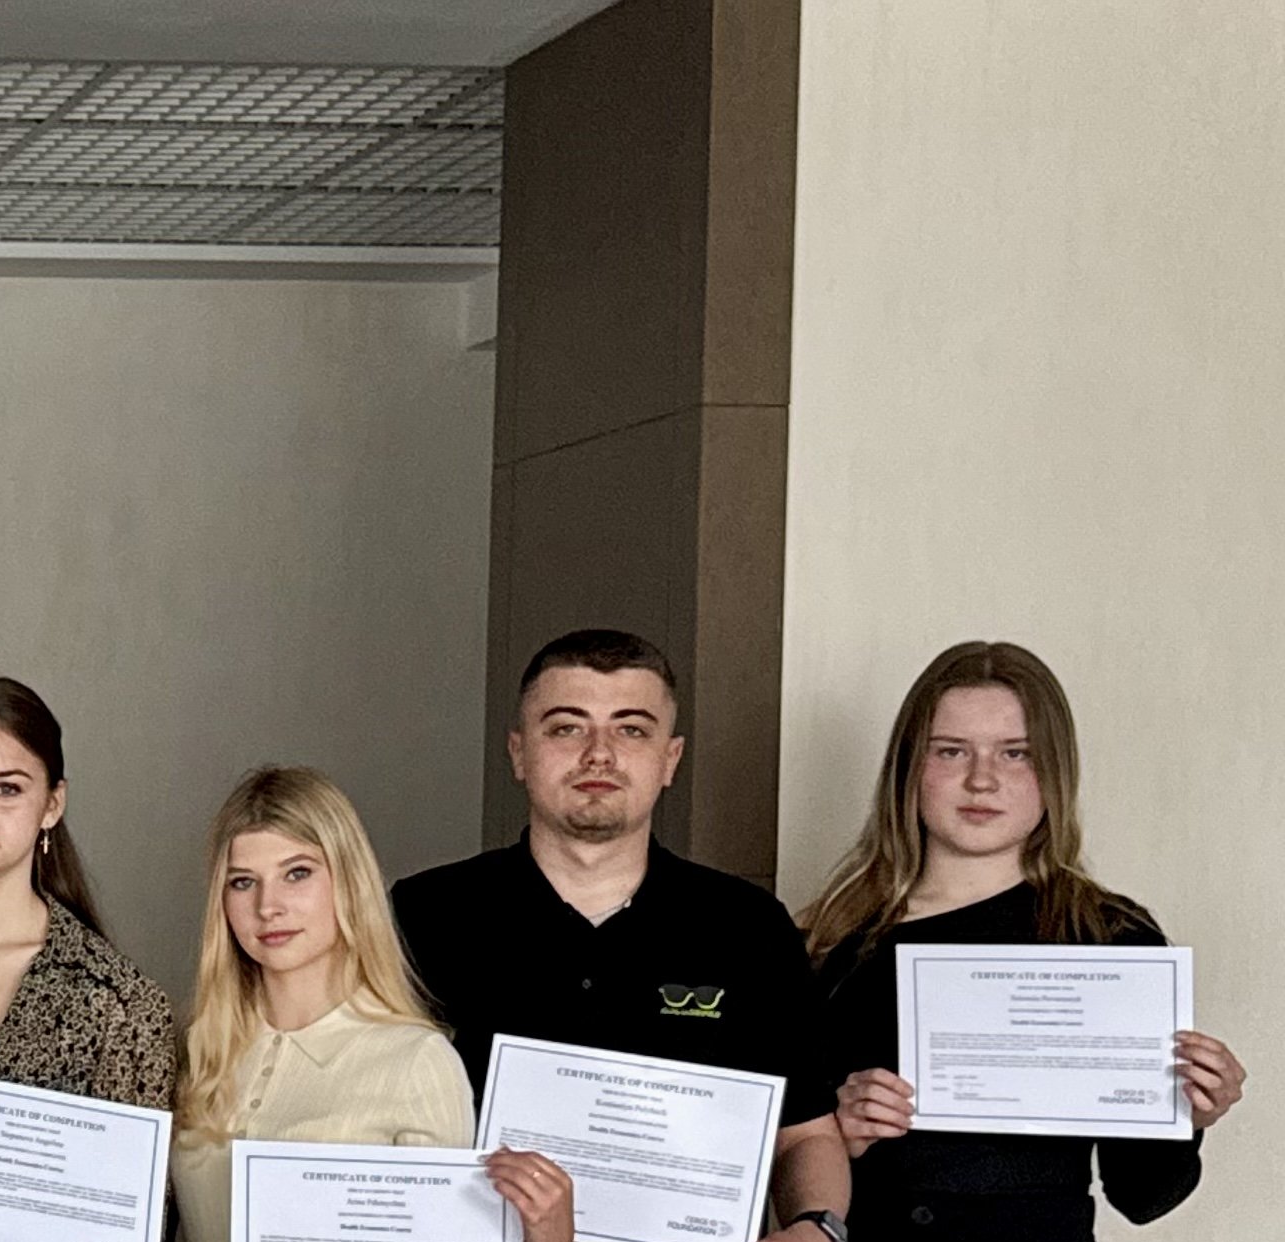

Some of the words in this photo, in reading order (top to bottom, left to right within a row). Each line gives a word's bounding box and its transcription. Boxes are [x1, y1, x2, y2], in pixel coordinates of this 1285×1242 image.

[1038, 972, 1050, 980] OF
[1054, 972, 1120, 980] COMPLETION
[556, 1067, 626, 1085] CERTIFICATE
[627, 1078, 642, 1087] OF
[644, 1080, 713, 1098] COMPLETION
[28, 1111, 41, 1120] OF
[42, 1113, 105, 1132] COMPLETION
[303, 1172, 367, 1182] CERTIFICATE
[369, 1174, 381, 1182] OF
[384, 1175, 450, 1185] COMPLETION
[666, 1220, 716, 1235] FOUNDATION
